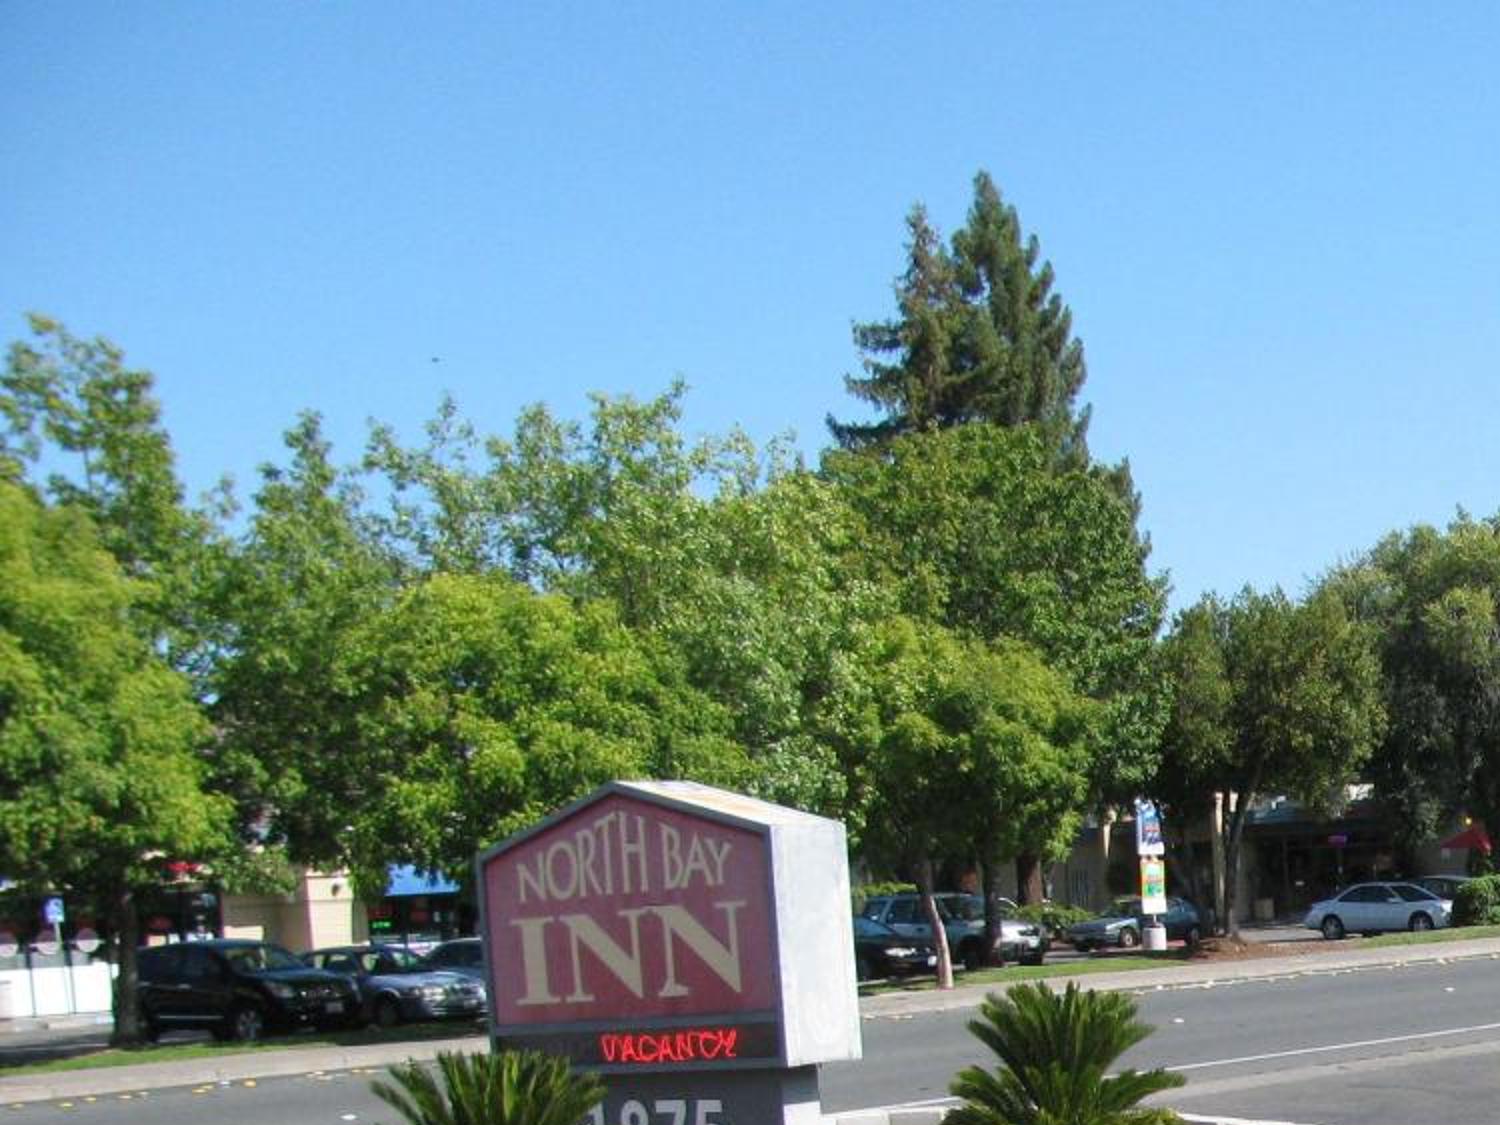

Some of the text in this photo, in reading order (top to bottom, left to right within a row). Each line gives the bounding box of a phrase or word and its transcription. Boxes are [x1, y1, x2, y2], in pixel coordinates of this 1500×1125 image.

[517, 811, 732, 902] NORTH BAY
[510, 901, 746, 1005] INN
[601, 1029, 737, 1062] VACANCY
